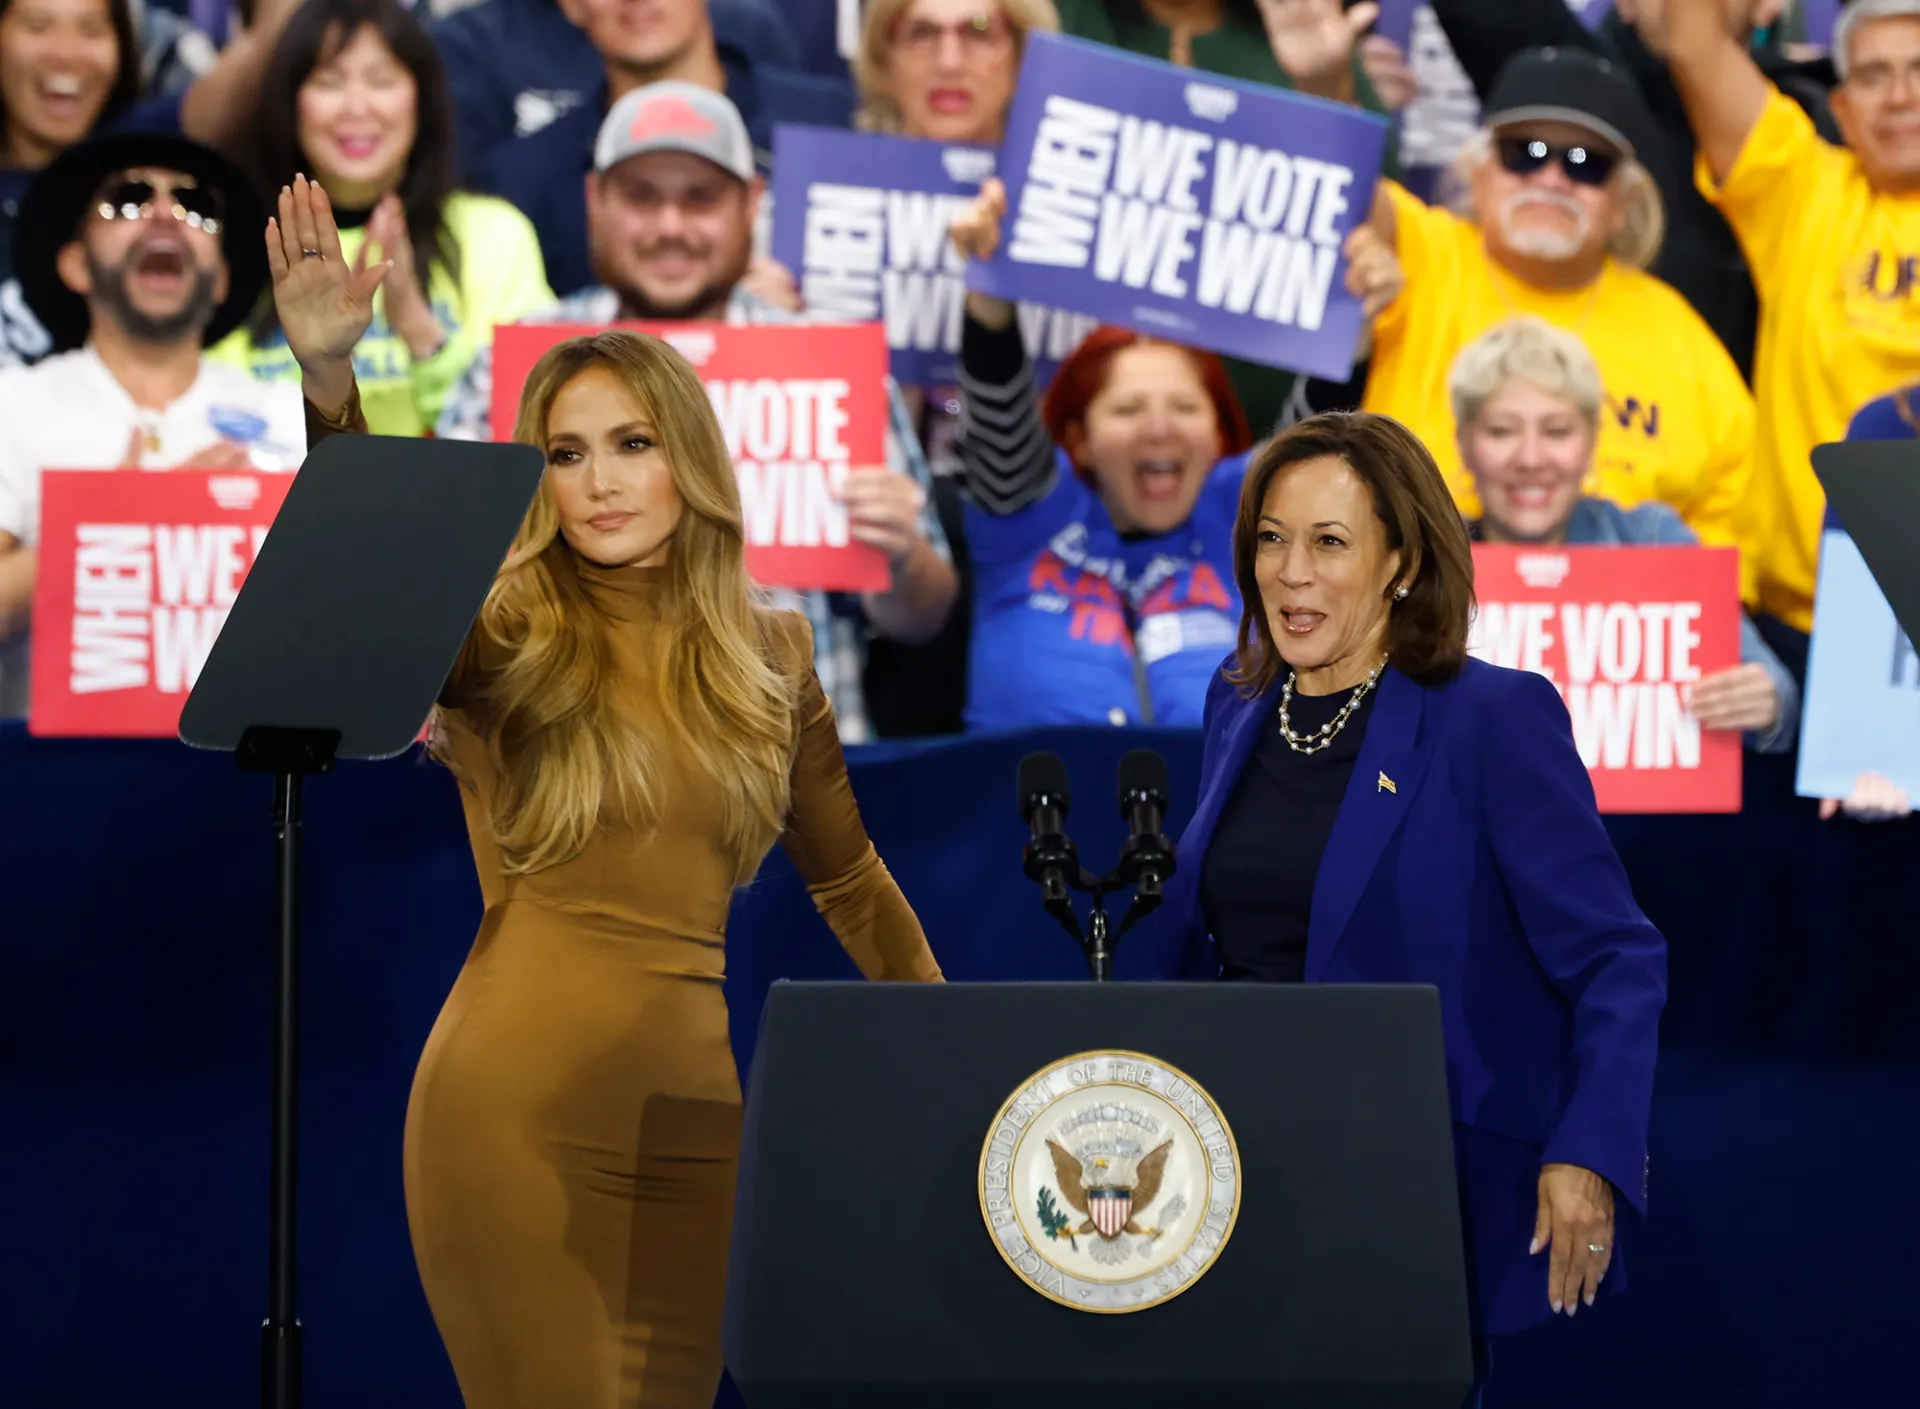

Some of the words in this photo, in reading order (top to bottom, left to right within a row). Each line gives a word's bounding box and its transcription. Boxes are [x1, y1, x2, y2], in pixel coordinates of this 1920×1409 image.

[1008, 93, 1123, 268] WHEN
[1113, 113, 1214, 214] WE
[1208, 137, 1354, 249] VOTE
[1093, 190, 1204, 300] WE
[1196, 218, 1339, 332] WIN
[707, 378, 850, 462] VOTE
[70, 523, 152, 694] WHEN
[153, 523, 248, 607] WE
[152, 605, 234, 694] W
[1466, 601, 1556, 682] WE
[1559, 601, 1702, 684] VOTE
[1566, 681, 1701, 770] WIN
[1067, 1063, 1097, 1086] OF
[1109, 1061, 1154, 1085] THE
[986, 1077, 1055, 1230] PRESIDENT
[1164, 1077, 1236, 1183] UNITED
[1008, 1237, 1067, 1298] VICE
